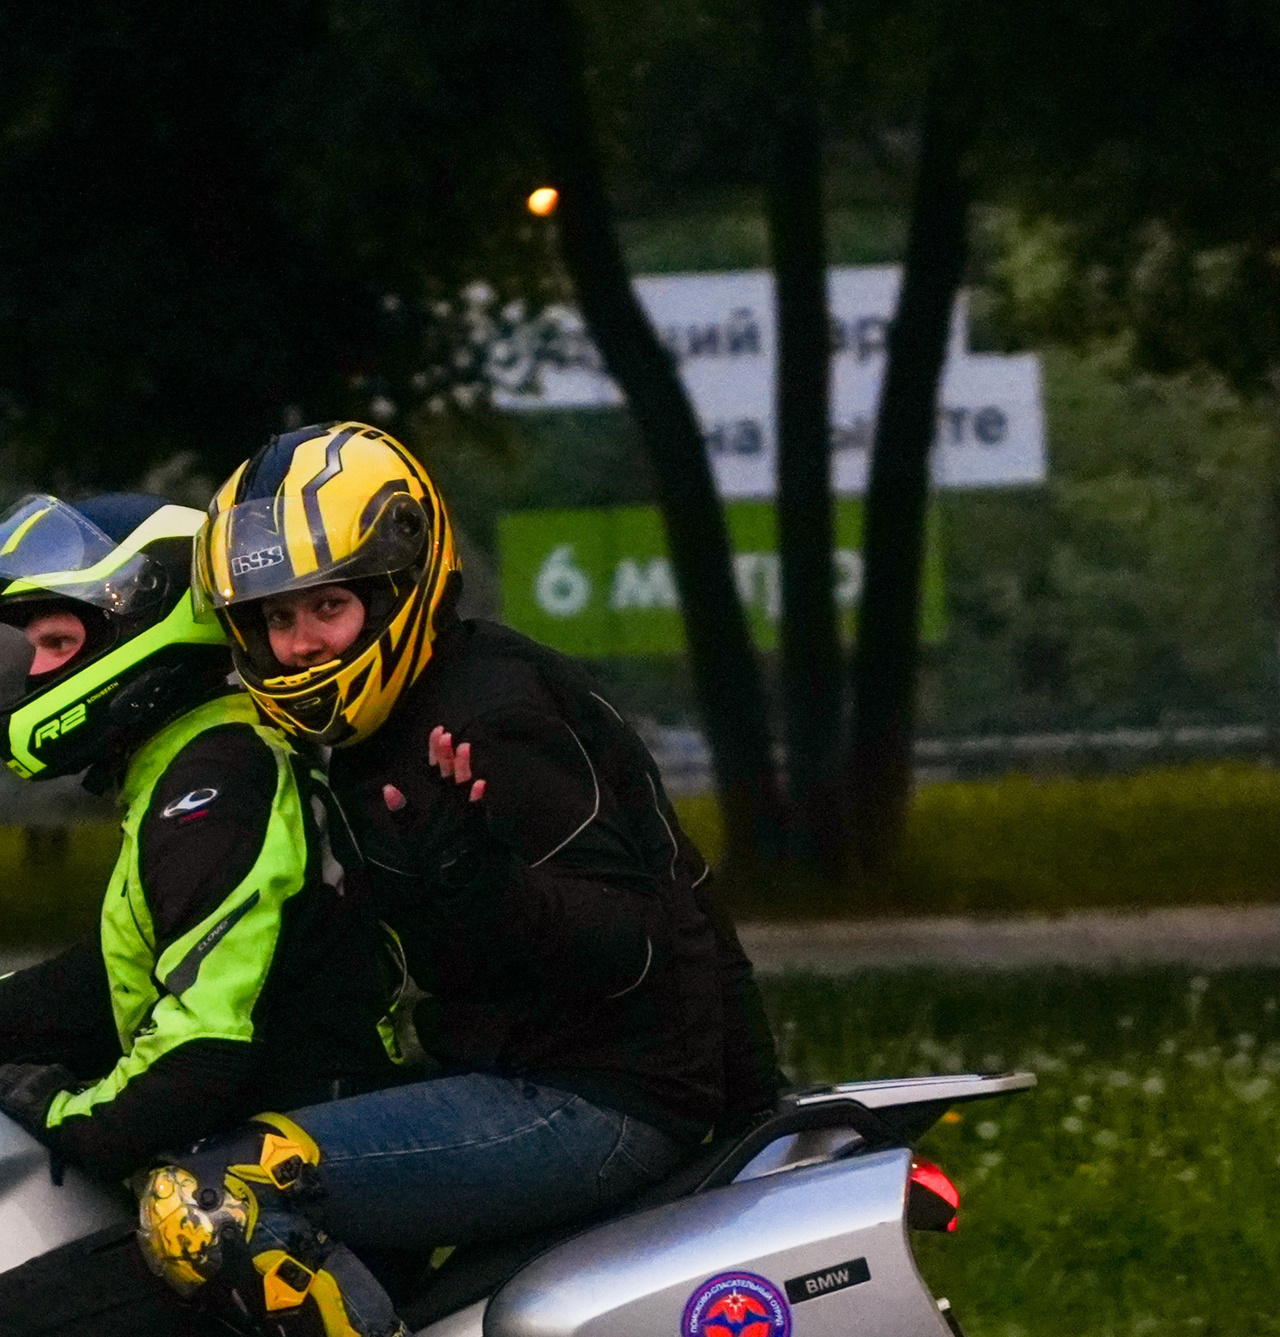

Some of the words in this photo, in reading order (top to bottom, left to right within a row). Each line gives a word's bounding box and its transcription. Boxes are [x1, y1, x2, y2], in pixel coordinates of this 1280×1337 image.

[535, 543, 589, 617] 6
[35, 702, 86, 749] R2
[805, 1268, 850, 1294] BMW
